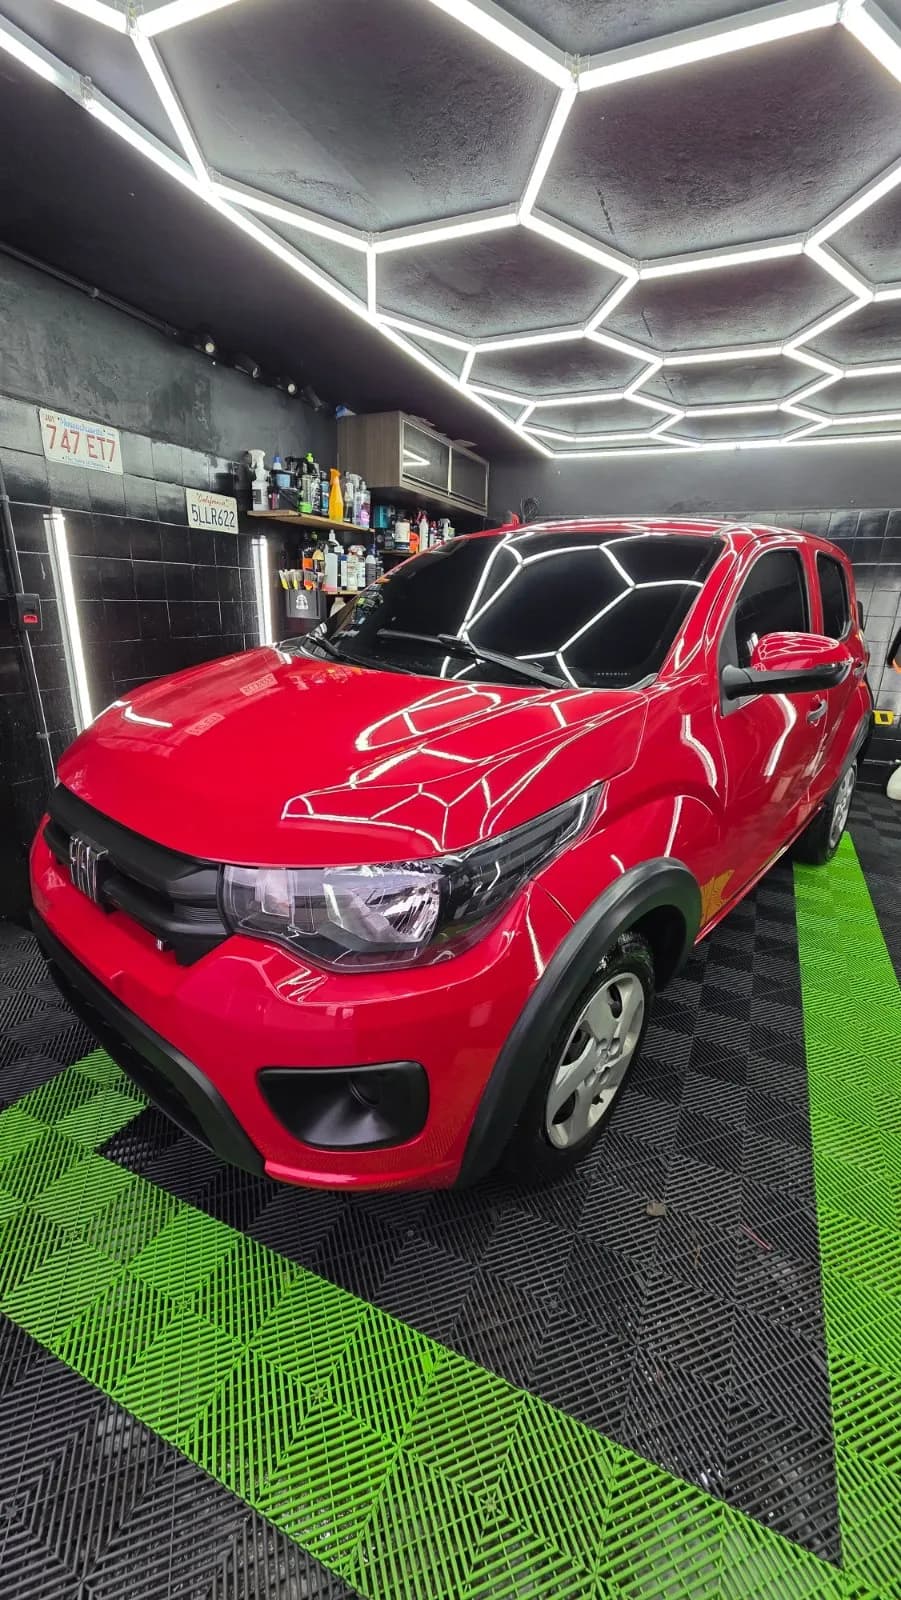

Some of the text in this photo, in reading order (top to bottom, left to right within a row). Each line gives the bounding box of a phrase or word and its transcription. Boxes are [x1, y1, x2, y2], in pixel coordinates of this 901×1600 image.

[46, 424, 80, 455] 747
[87, 434, 115, 462] ET7
[191, 503, 236, 528] 5LLR622
